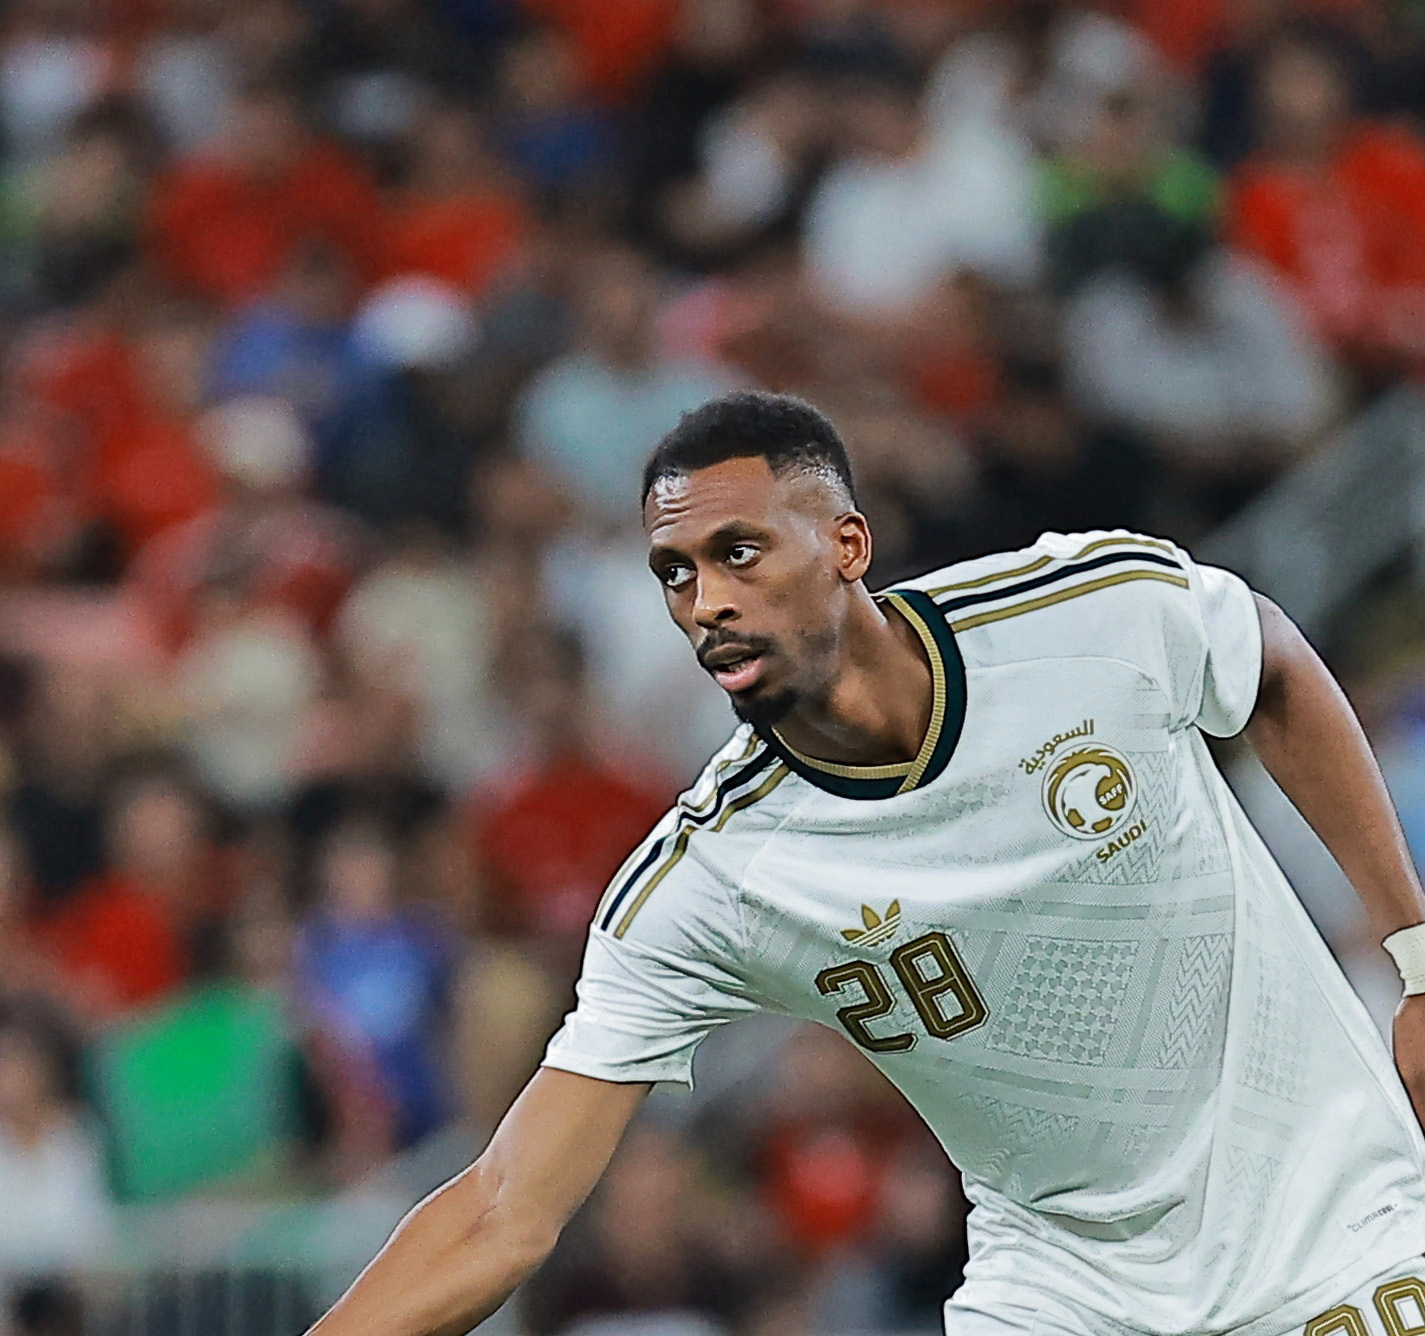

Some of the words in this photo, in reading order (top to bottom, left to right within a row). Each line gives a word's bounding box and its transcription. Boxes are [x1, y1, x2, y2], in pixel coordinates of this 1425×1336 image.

[1018, 719, 1095, 776] السعودية
[1099, 783, 1124, 806] SAFF
[1096, 819, 1148, 864] SAUDI
[815, 931, 990, 1054] 28
